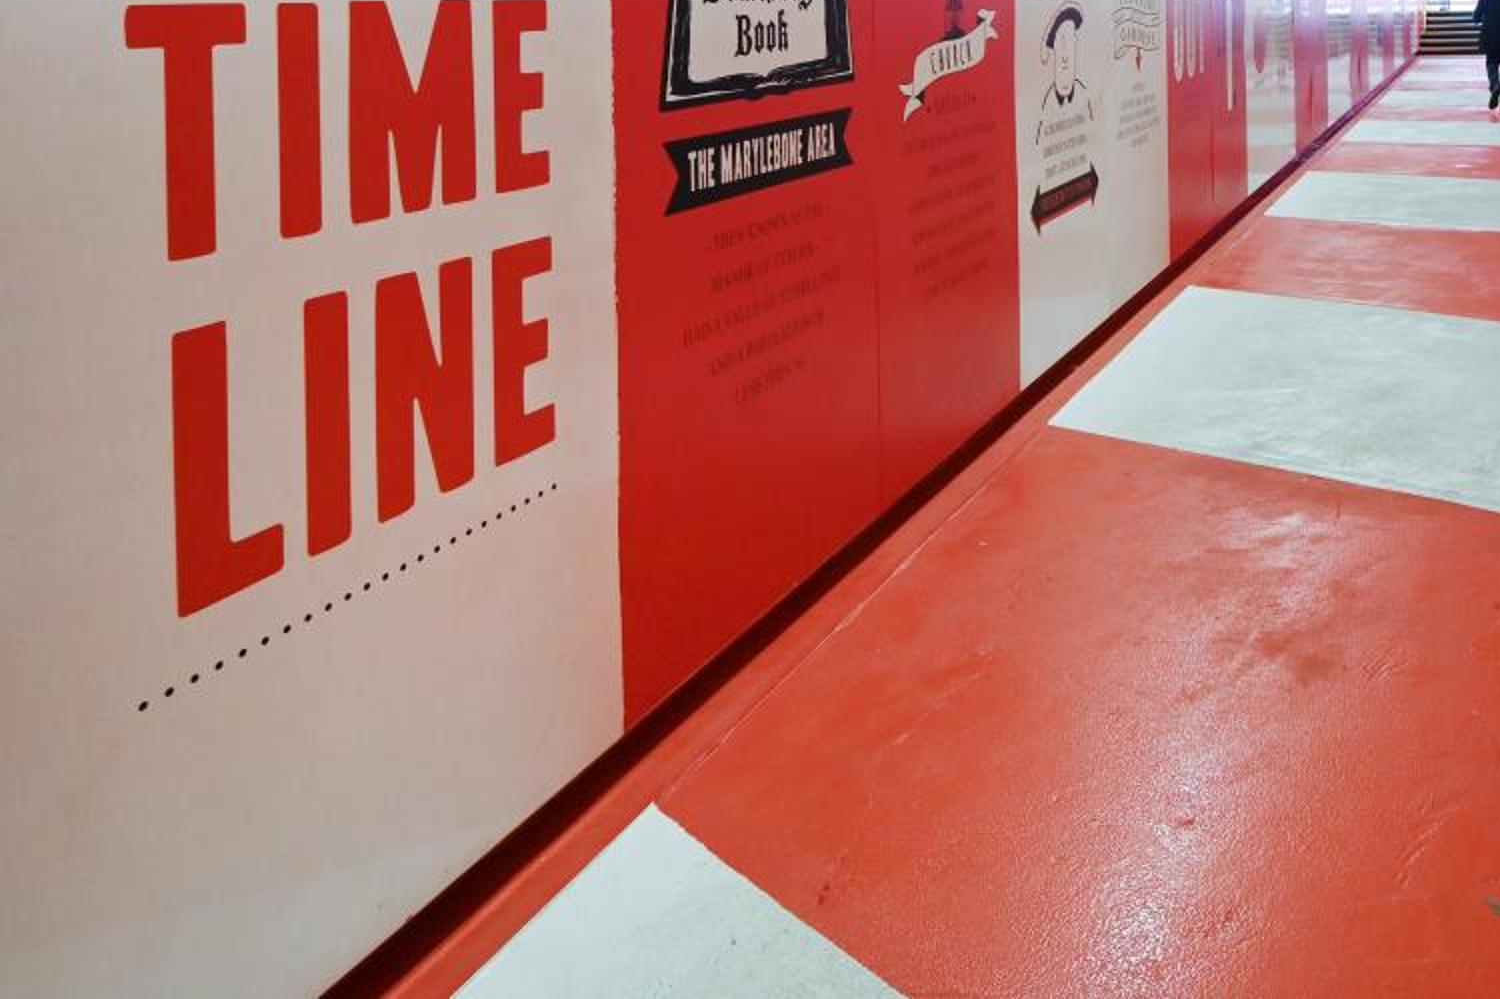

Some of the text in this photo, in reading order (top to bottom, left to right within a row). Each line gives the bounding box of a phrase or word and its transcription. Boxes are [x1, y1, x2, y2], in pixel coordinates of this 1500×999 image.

[734, 9, 789, 58] Book
[687, 122, 837, 193] THE MARYLEBONE AREA
[171, 236, 556, 618] LINE
